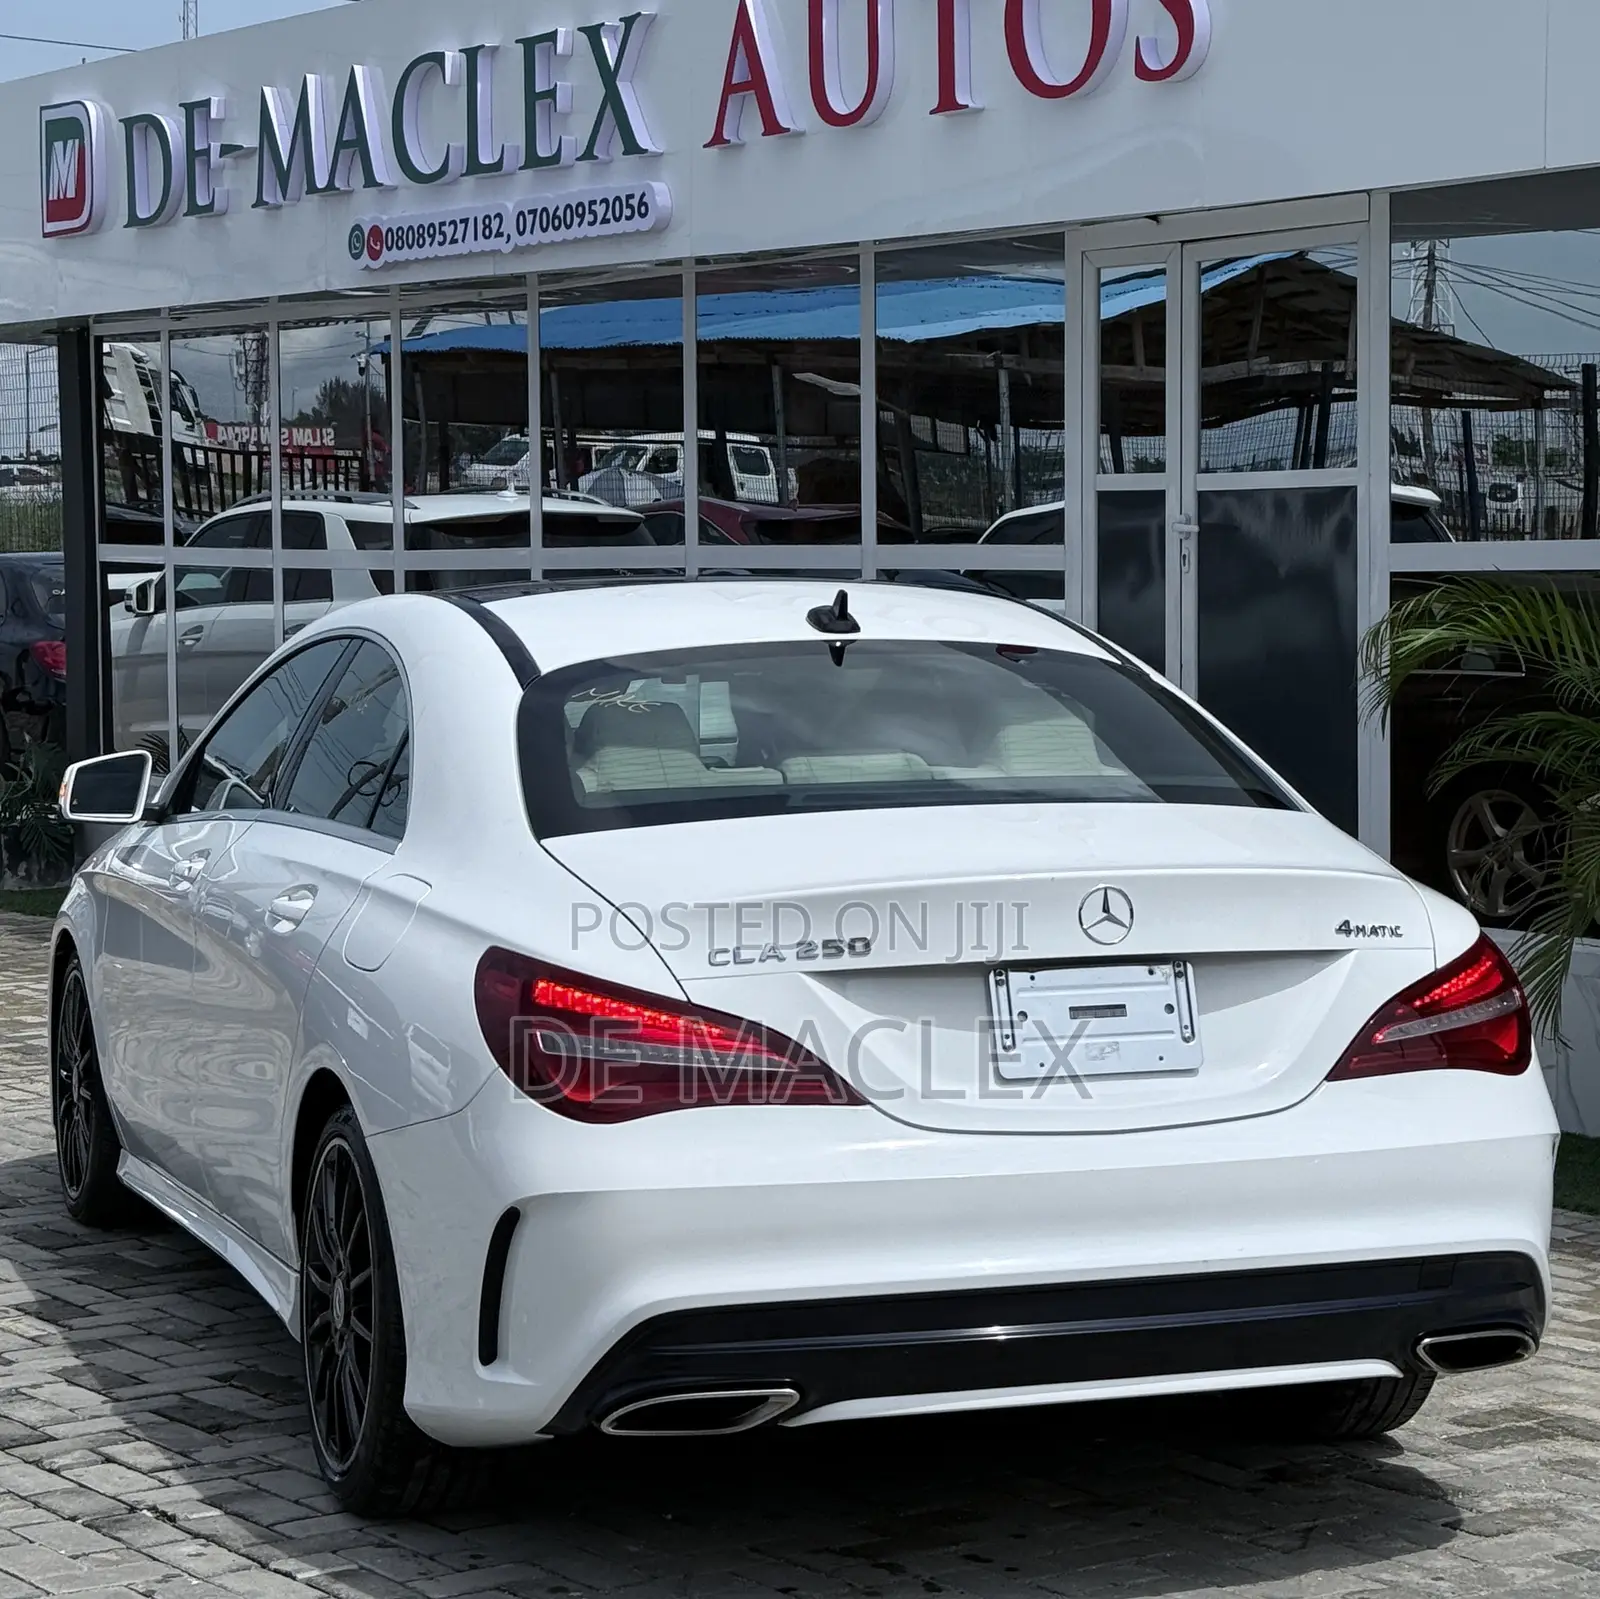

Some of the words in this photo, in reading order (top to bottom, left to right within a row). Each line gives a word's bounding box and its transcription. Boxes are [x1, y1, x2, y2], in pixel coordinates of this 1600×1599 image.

[118, 12, 658, 228] DE-MACLEX
[384, 212, 512, 253] 08089527182,
[515, 191, 650, 237] 07060952056
[708, 943, 787, 967] CLA
[796, 936, 873, 960] 250
[1334, 919, 1404, 938] 4MATIC
